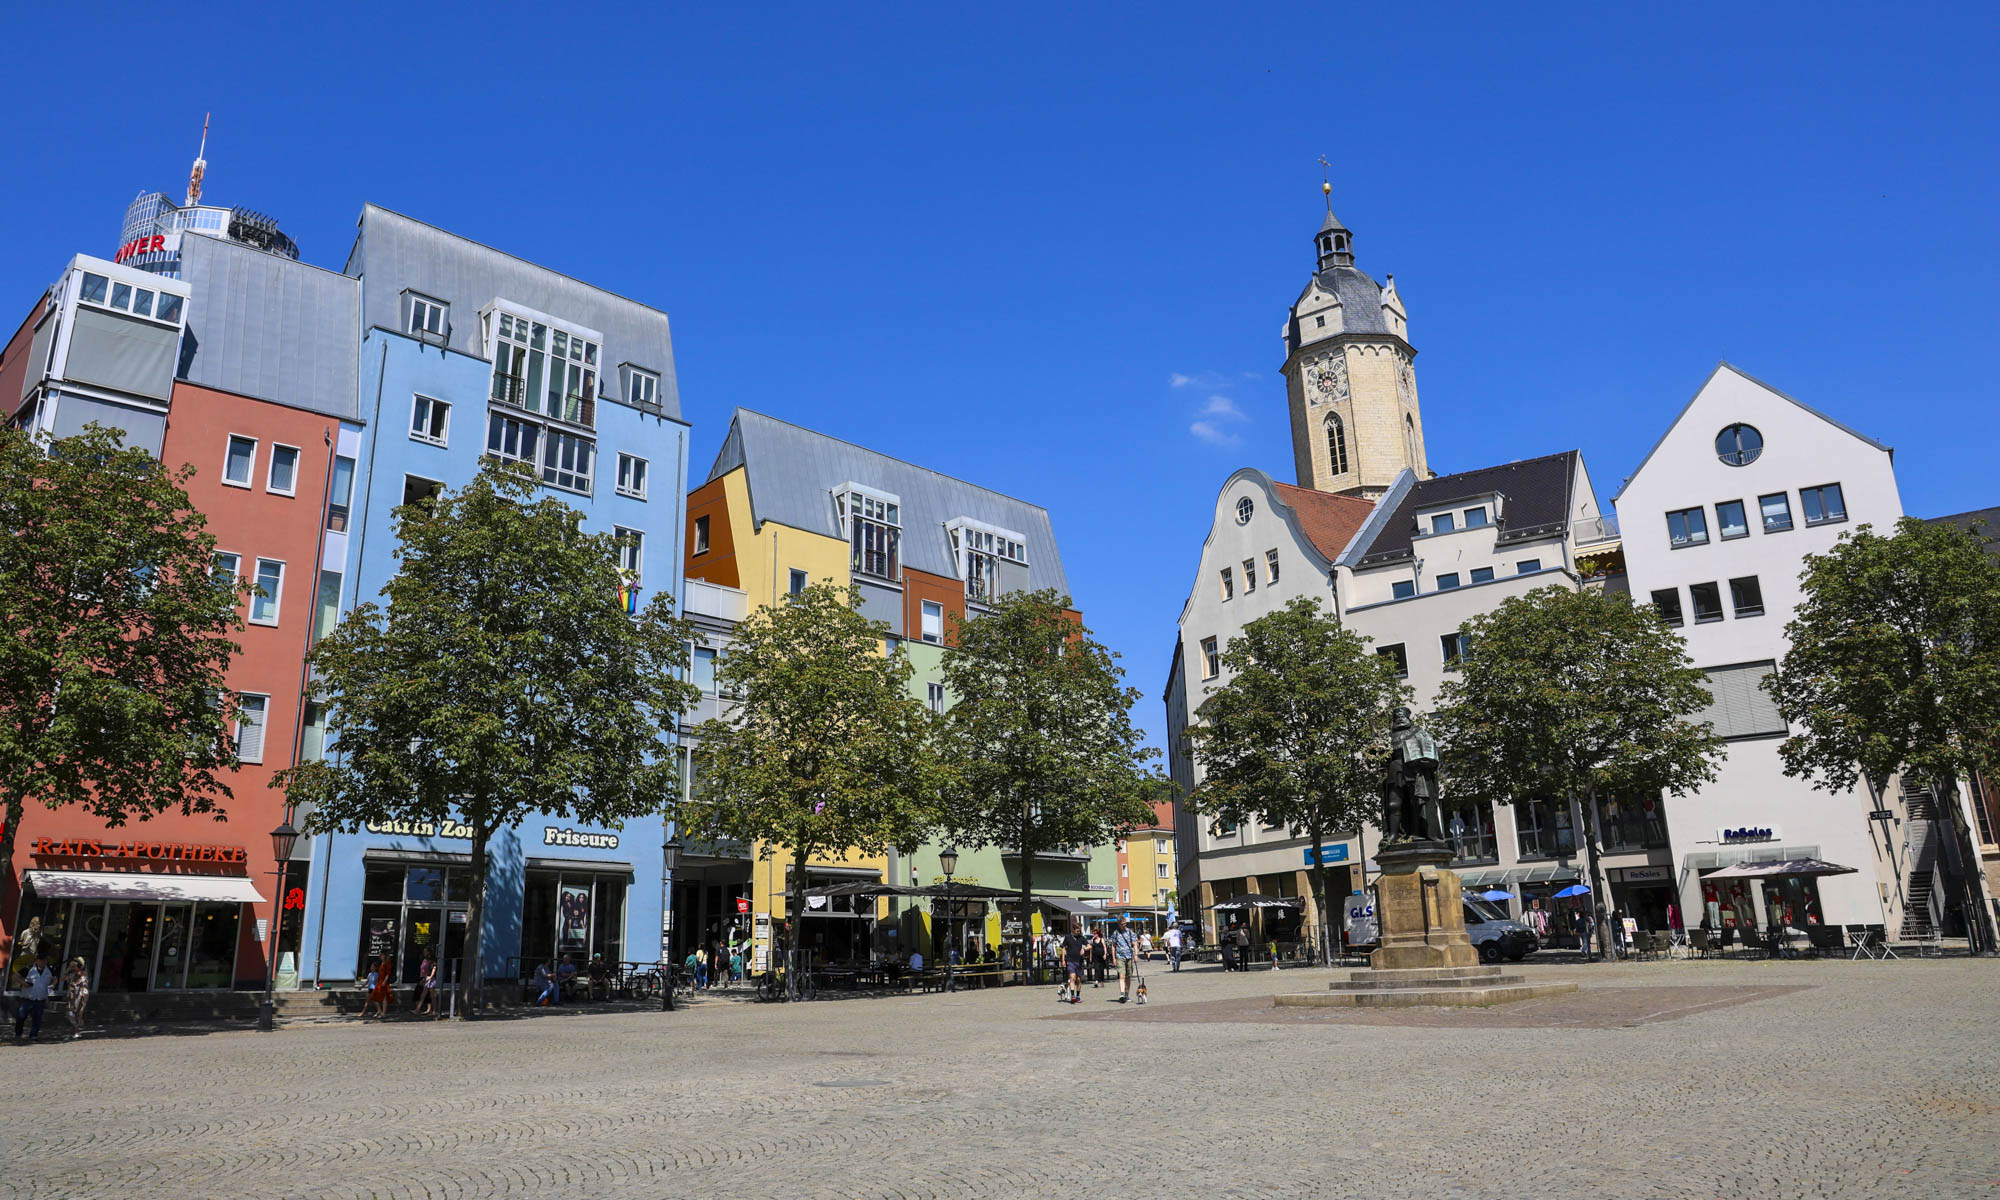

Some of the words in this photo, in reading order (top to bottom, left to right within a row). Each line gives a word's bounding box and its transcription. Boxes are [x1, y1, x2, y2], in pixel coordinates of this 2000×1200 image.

[366, 818, 435, 836] Catrin
[544, 822, 618, 848] Friseure
[1723, 826, 1773, 840] ReSales
[36, 836, 247, 864] RATS-APOTHEKE
[1630, 868, 1661, 879] ReSales
[1350, 905, 1374, 919] GLS
